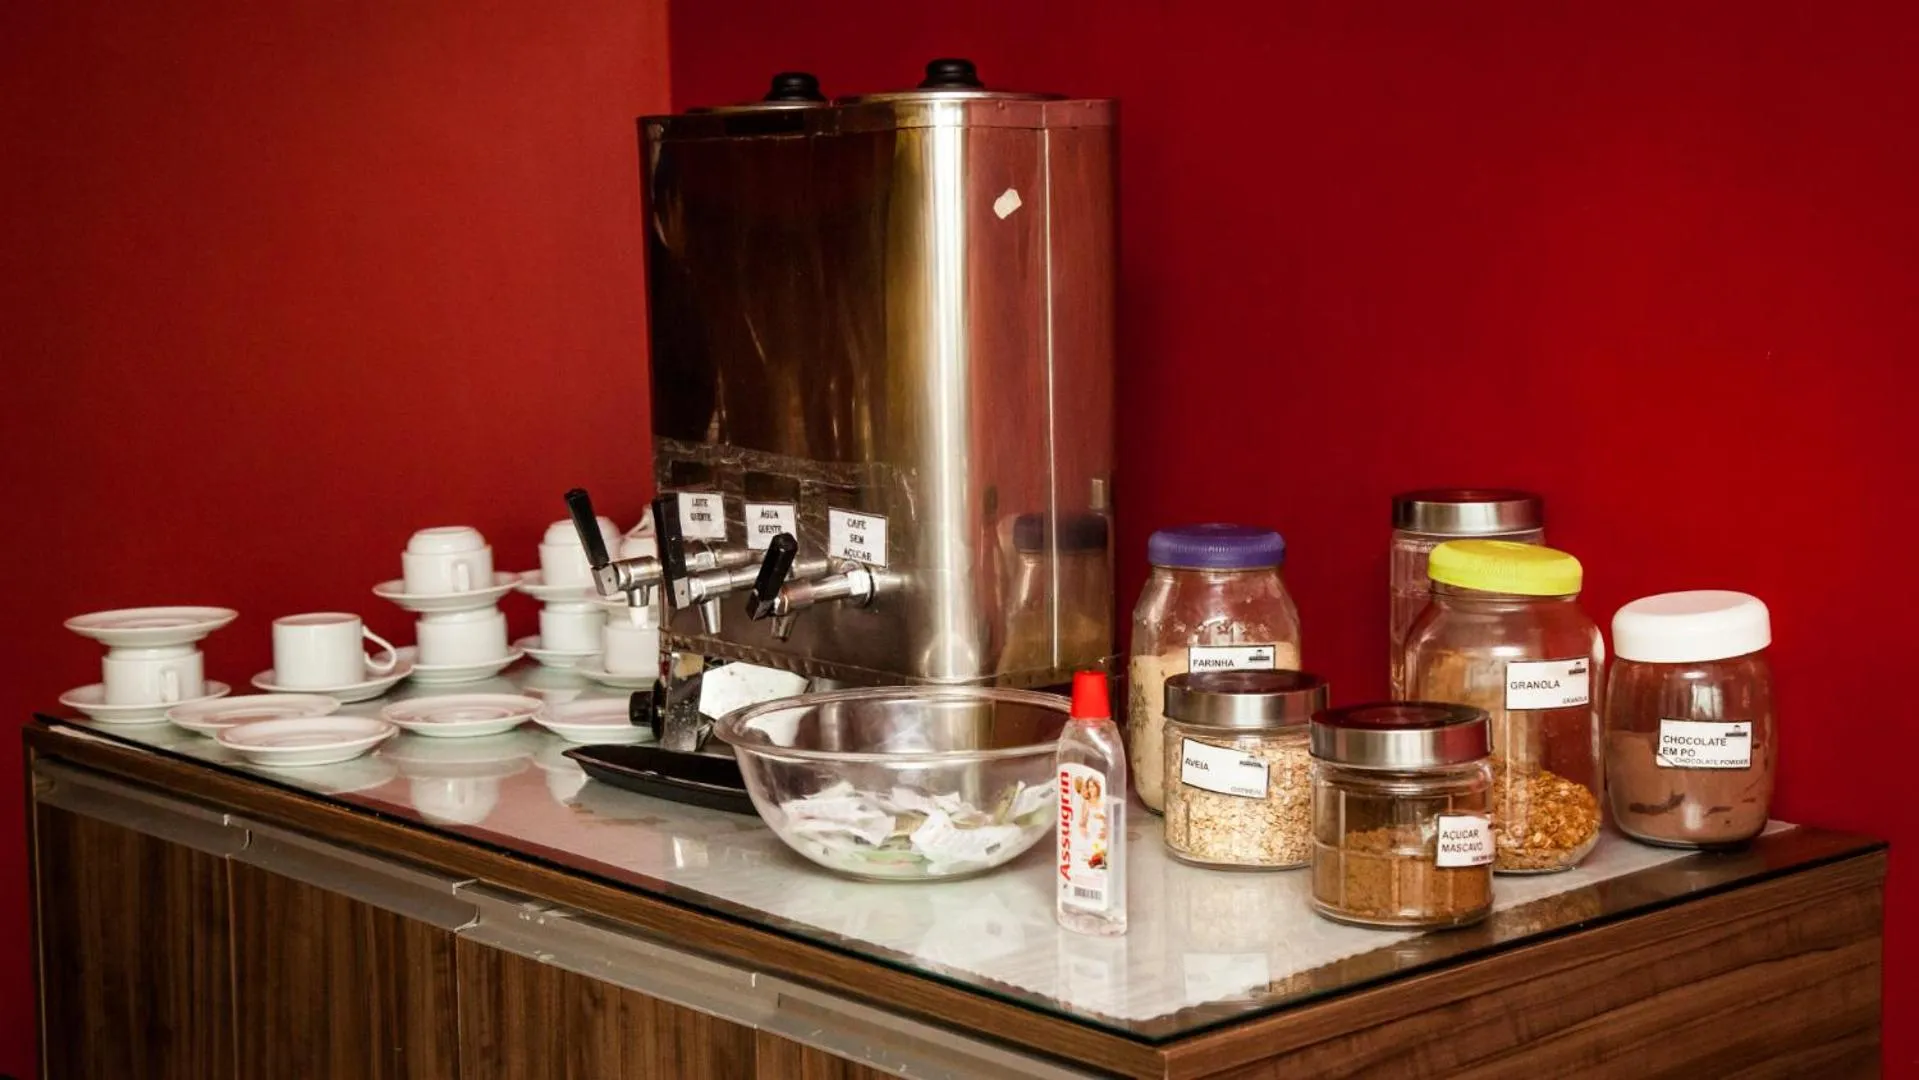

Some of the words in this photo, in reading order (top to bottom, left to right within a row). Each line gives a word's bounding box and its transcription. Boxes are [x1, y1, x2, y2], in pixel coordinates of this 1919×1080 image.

[849, 534, 864, 545] SEM
[1193, 658, 1235, 668] FARINHA
[1510, 680, 1561, 690] GRANOLA
[1663, 735, 1727, 746] CHOCOLATE
[1662, 747, 1678, 756] EM
[1184, 757, 1209, 771] AVEIA
[1675, 757, 1720, 766] CHOCOLATE
[1060, 771, 1073, 881] Assugrin
[1441, 842, 1483, 853] MASCAVO
